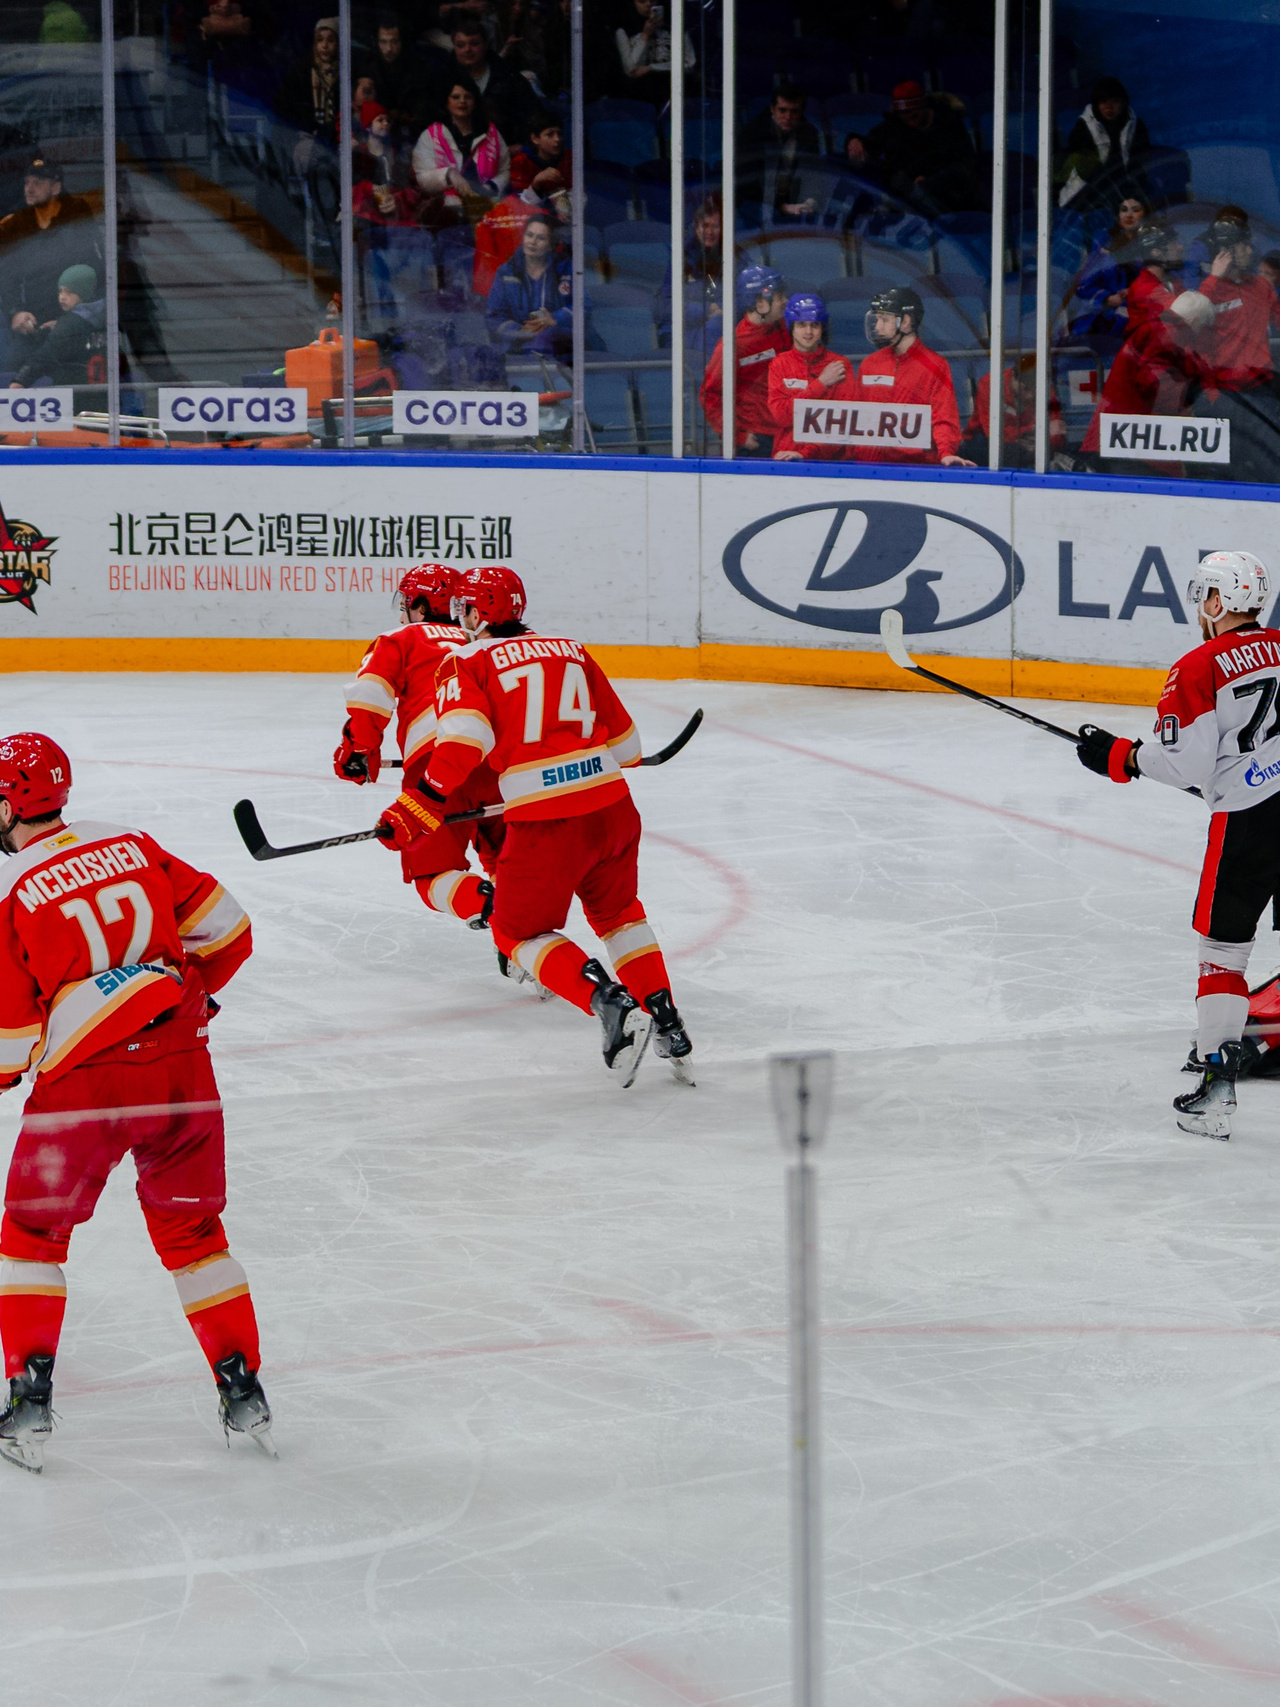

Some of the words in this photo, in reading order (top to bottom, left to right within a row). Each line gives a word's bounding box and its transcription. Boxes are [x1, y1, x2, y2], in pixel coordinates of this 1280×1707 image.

[170, 396, 296, 422] согаз
[405, 399, 528, 427] согаз
[802, 406, 923, 439] KHL.RU
[1109, 421, 1222, 454] KHL.RU
[108, 511, 513, 560] 北京昆仑鸿星冰球俱乐部
[109, 564, 186, 591] BEIJING
[194, 565, 272, 592] KUNLUN
[280, 566, 317, 592] RED
[324, 566, 380, 593] STAR
[510, 593, 522, 606] 74
[421, 624, 466, 642] DUS
[490, 638, 586, 670] GRAOVAC
[435, 676, 462, 714] 74
[497, 661, 597, 745] 74
[1153, 713, 1180, 747] 0
[50, 766, 64, 785] 12
[541, 755, 603, 787] SIBUR
[16, 840, 150, 914] MCCOSHEN
[58, 879, 154, 975] 12
